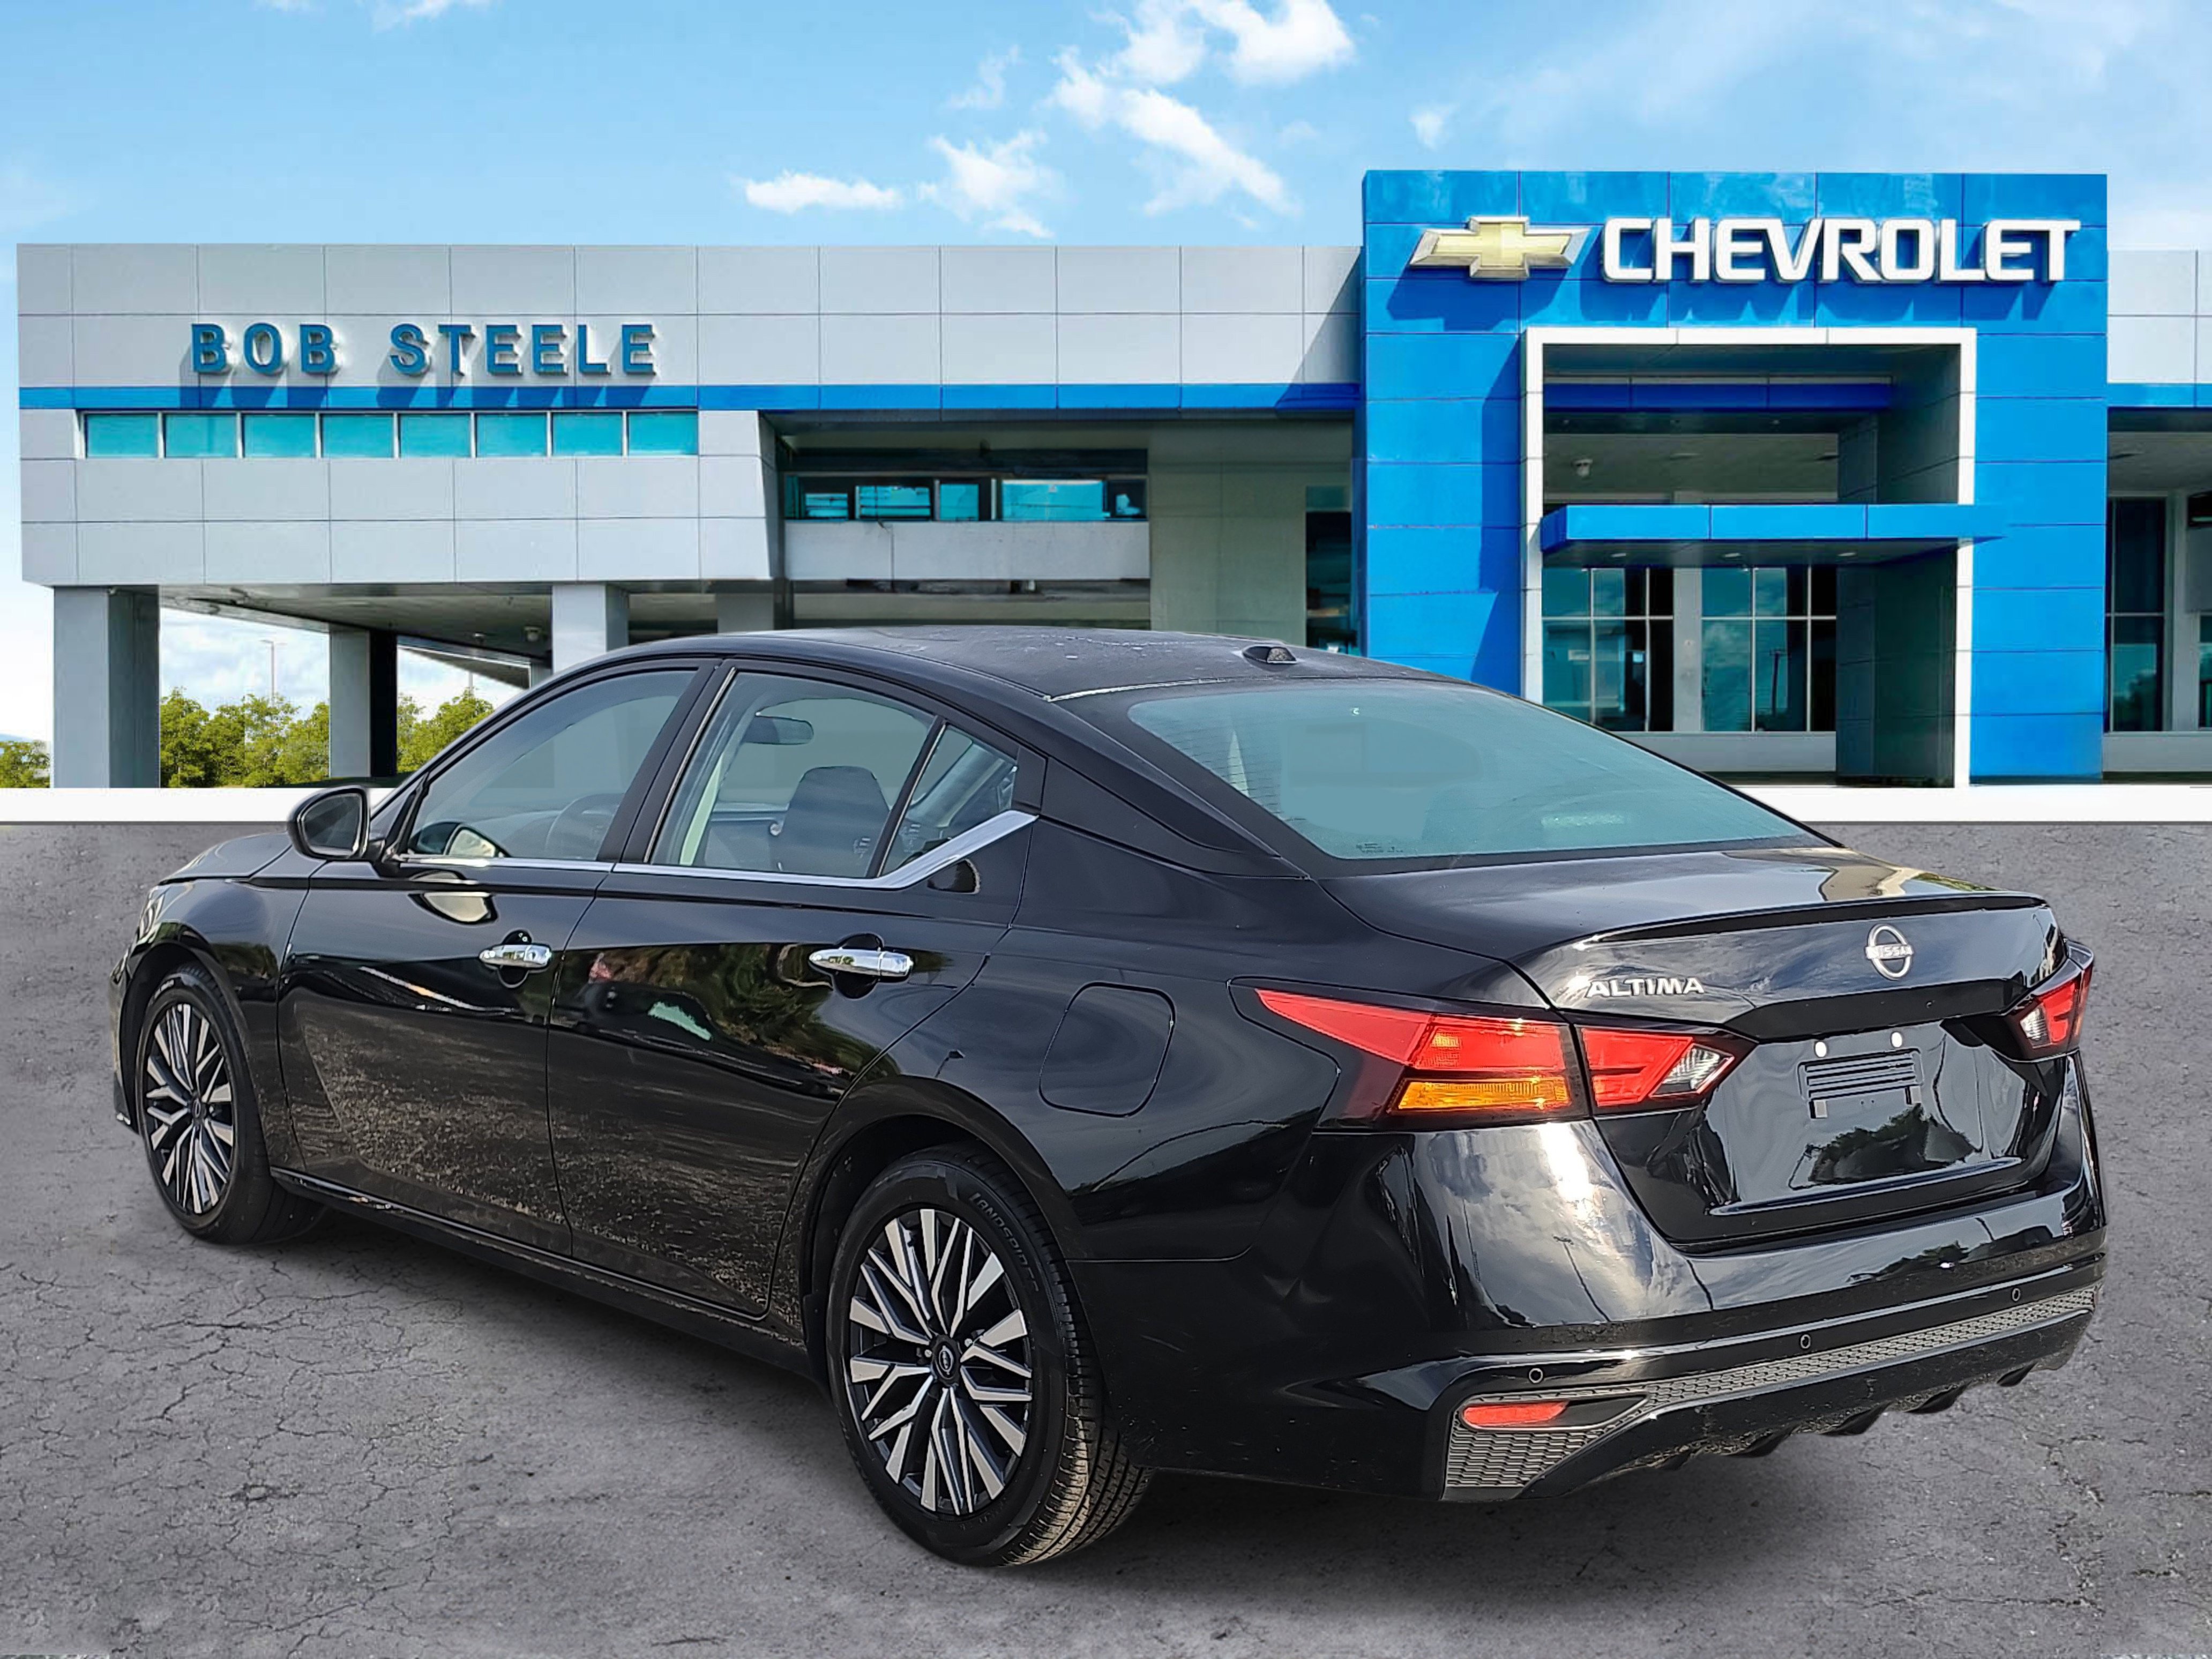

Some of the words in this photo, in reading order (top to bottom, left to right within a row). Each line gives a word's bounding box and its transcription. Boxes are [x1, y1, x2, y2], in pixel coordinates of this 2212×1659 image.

[1602, 218, 2081, 283] CHEVROLET
[191, 323, 337, 374] BOB
[390, 323, 655, 375] STEELE
[1586, 977, 1704, 998] ALTIMA
